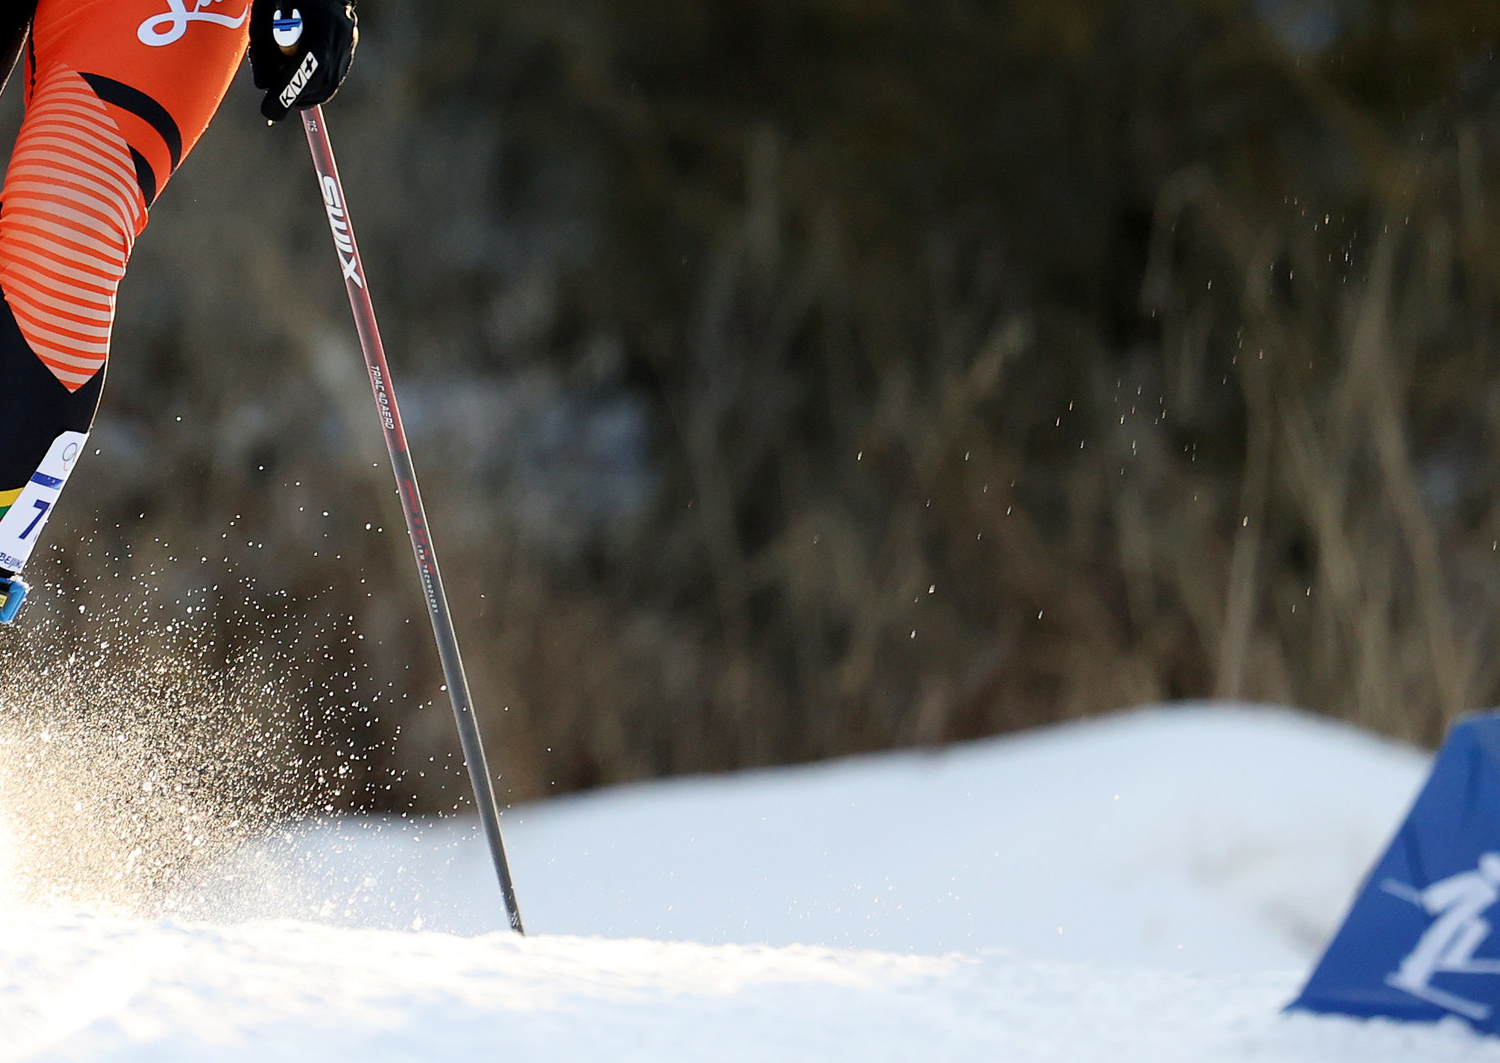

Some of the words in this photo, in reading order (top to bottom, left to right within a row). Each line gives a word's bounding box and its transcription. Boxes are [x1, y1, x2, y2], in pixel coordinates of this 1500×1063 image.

[279, 51, 319, 108] KV+
[317, 170, 363, 289] SWIX
[370, 365, 385, 392] TRIAC
[18, 499, 52, 542] 7
